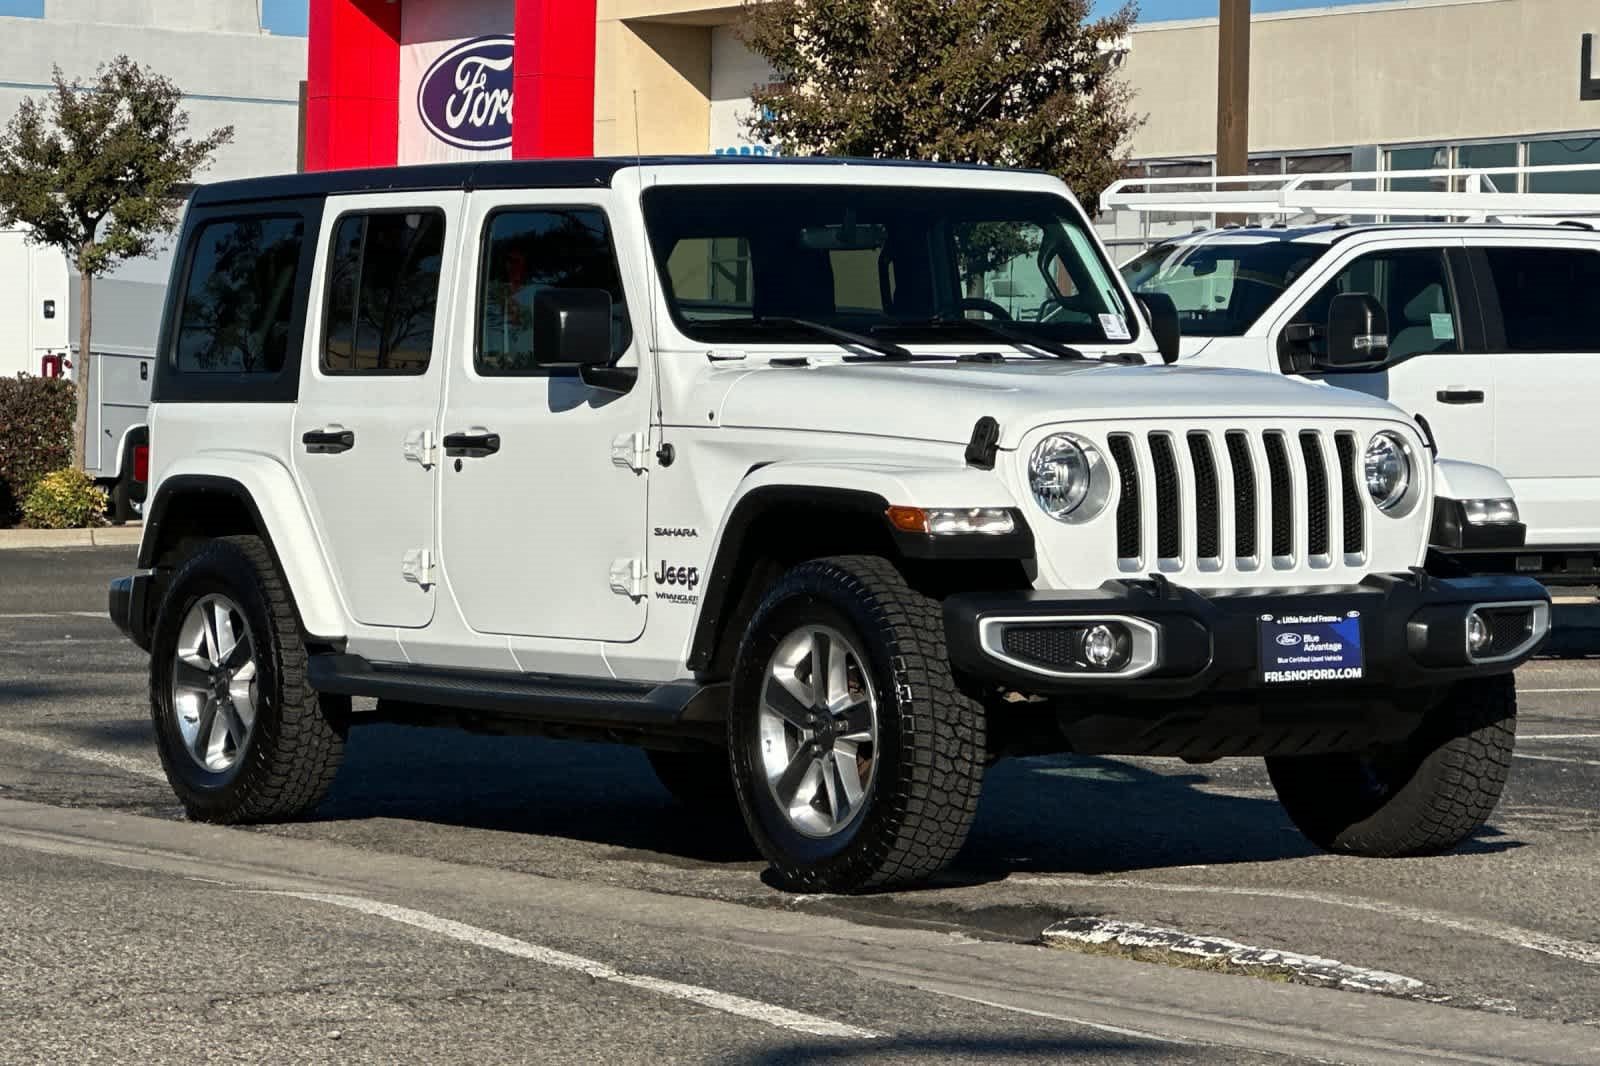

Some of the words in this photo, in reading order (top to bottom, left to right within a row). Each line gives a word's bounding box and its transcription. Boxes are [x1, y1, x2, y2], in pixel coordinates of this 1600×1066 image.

[654, 527, 698, 537] SAHARA
[654, 559, 699, 590] Jeep
[1303, 634, 1320, 642] Blue
[1303, 642, 1342, 652] Advantage
[1264, 667, 1362, 682] FRESNOFORD.COM
